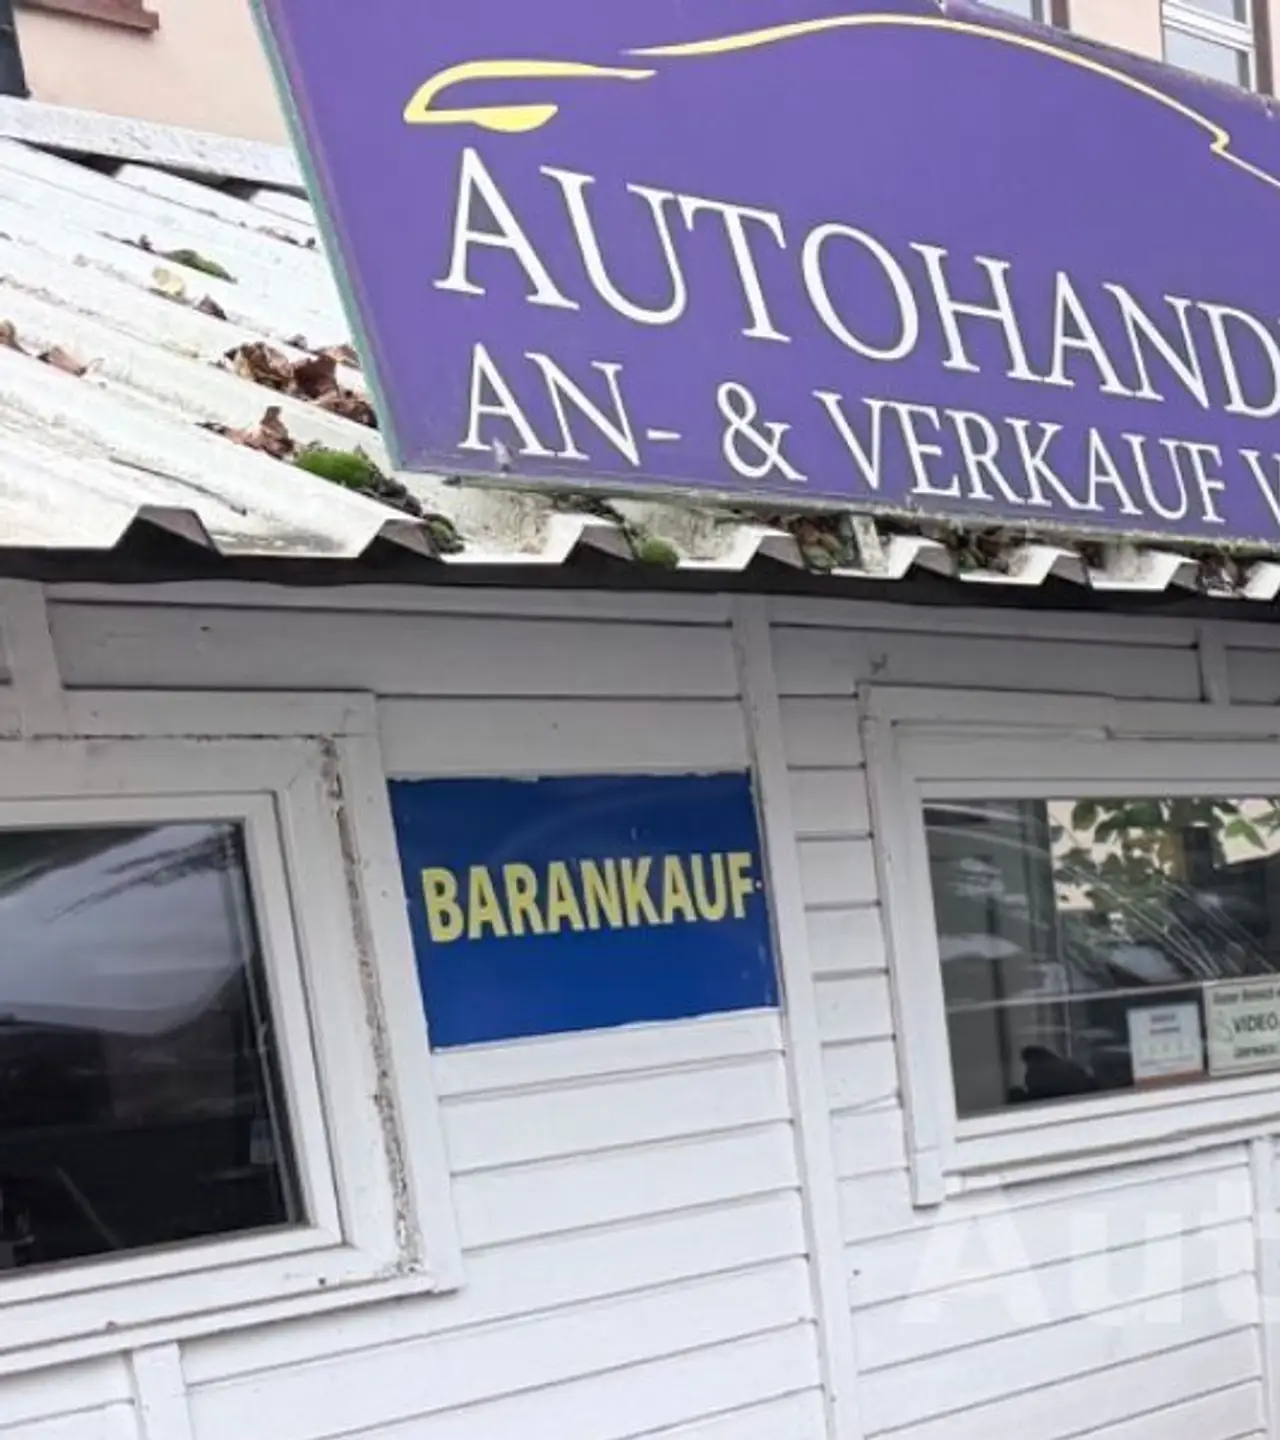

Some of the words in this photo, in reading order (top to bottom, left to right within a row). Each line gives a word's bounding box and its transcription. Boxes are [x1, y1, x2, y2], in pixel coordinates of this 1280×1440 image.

[458, 342, 681, 467] AN-
[717, 381, 807, 482] &
[813, 390, 1225, 524] VERKAUF
[422, 851, 753, 942] BARANKAUF
[1231, 1011, 1279, 1033] VIDEO
